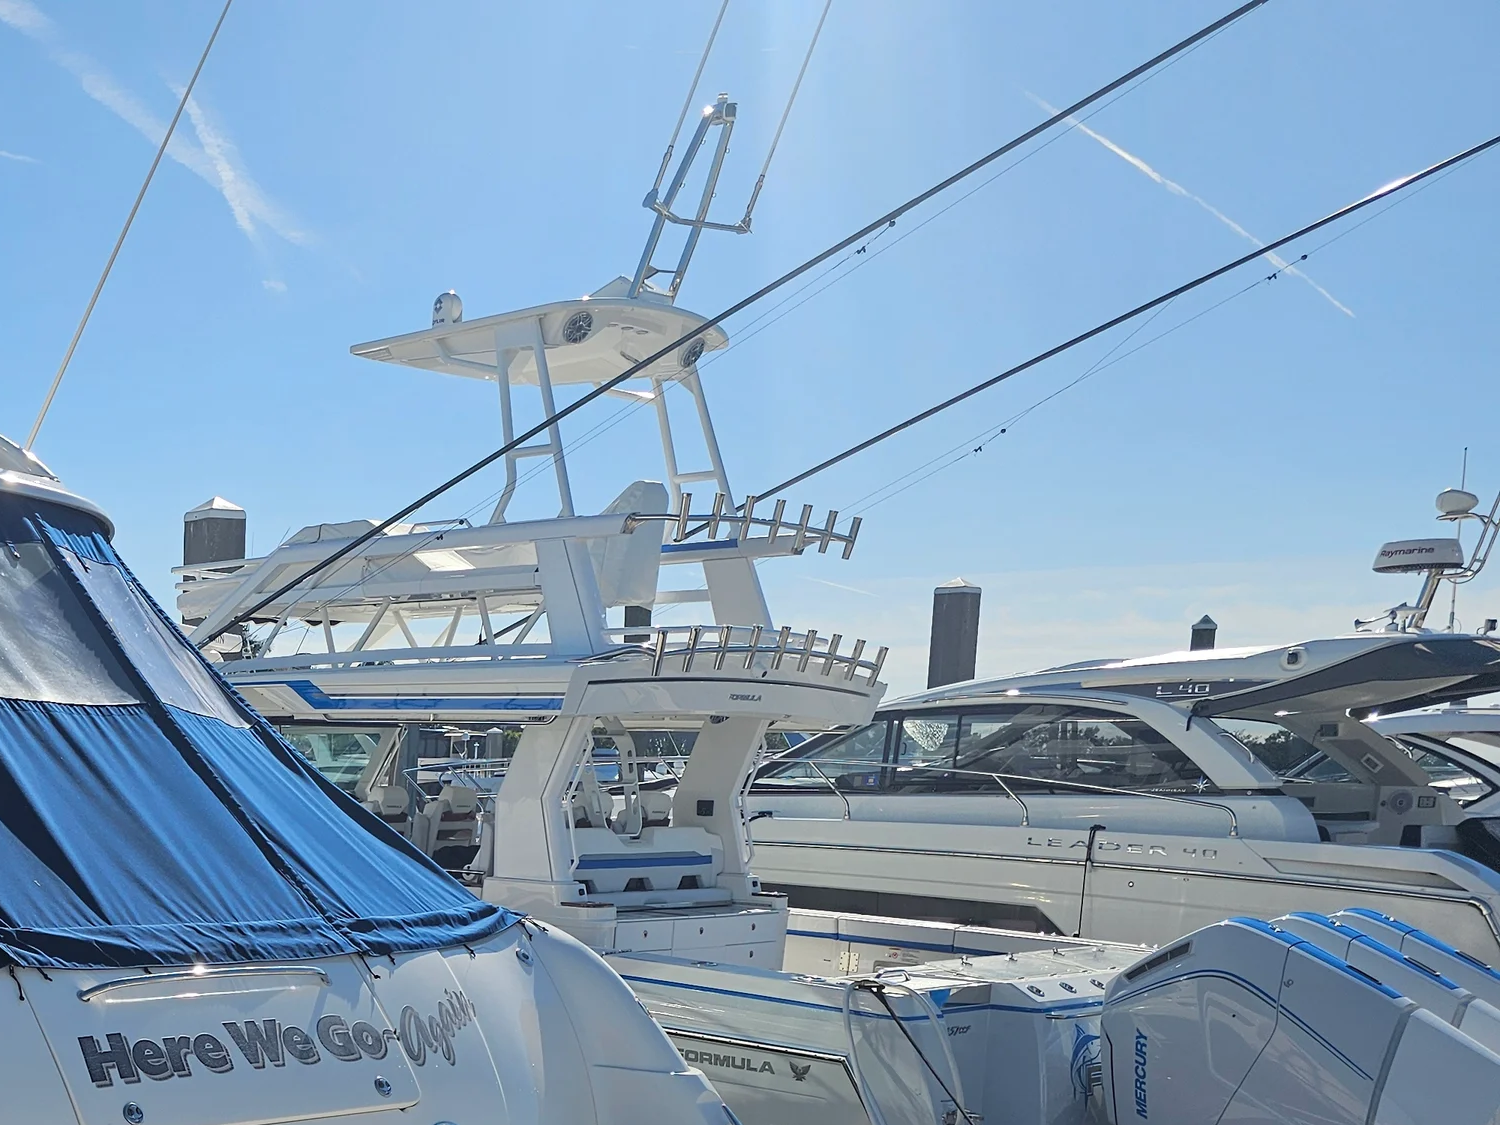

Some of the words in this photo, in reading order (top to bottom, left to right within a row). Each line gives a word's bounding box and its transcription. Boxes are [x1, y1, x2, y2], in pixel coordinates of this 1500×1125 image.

[1380, 546, 1435, 558] Raymarine
[1179, 683, 1209, 693] 40
[1027, 837, 1167, 857] LEADER
[1183, 847, 1218, 860] 40
[77, 1032, 235, 1088] Here
[221, 1017, 321, 1070] We
[399, 986, 476, 1067] Again
[1135, 1027, 1148, 1120] MERCURY
